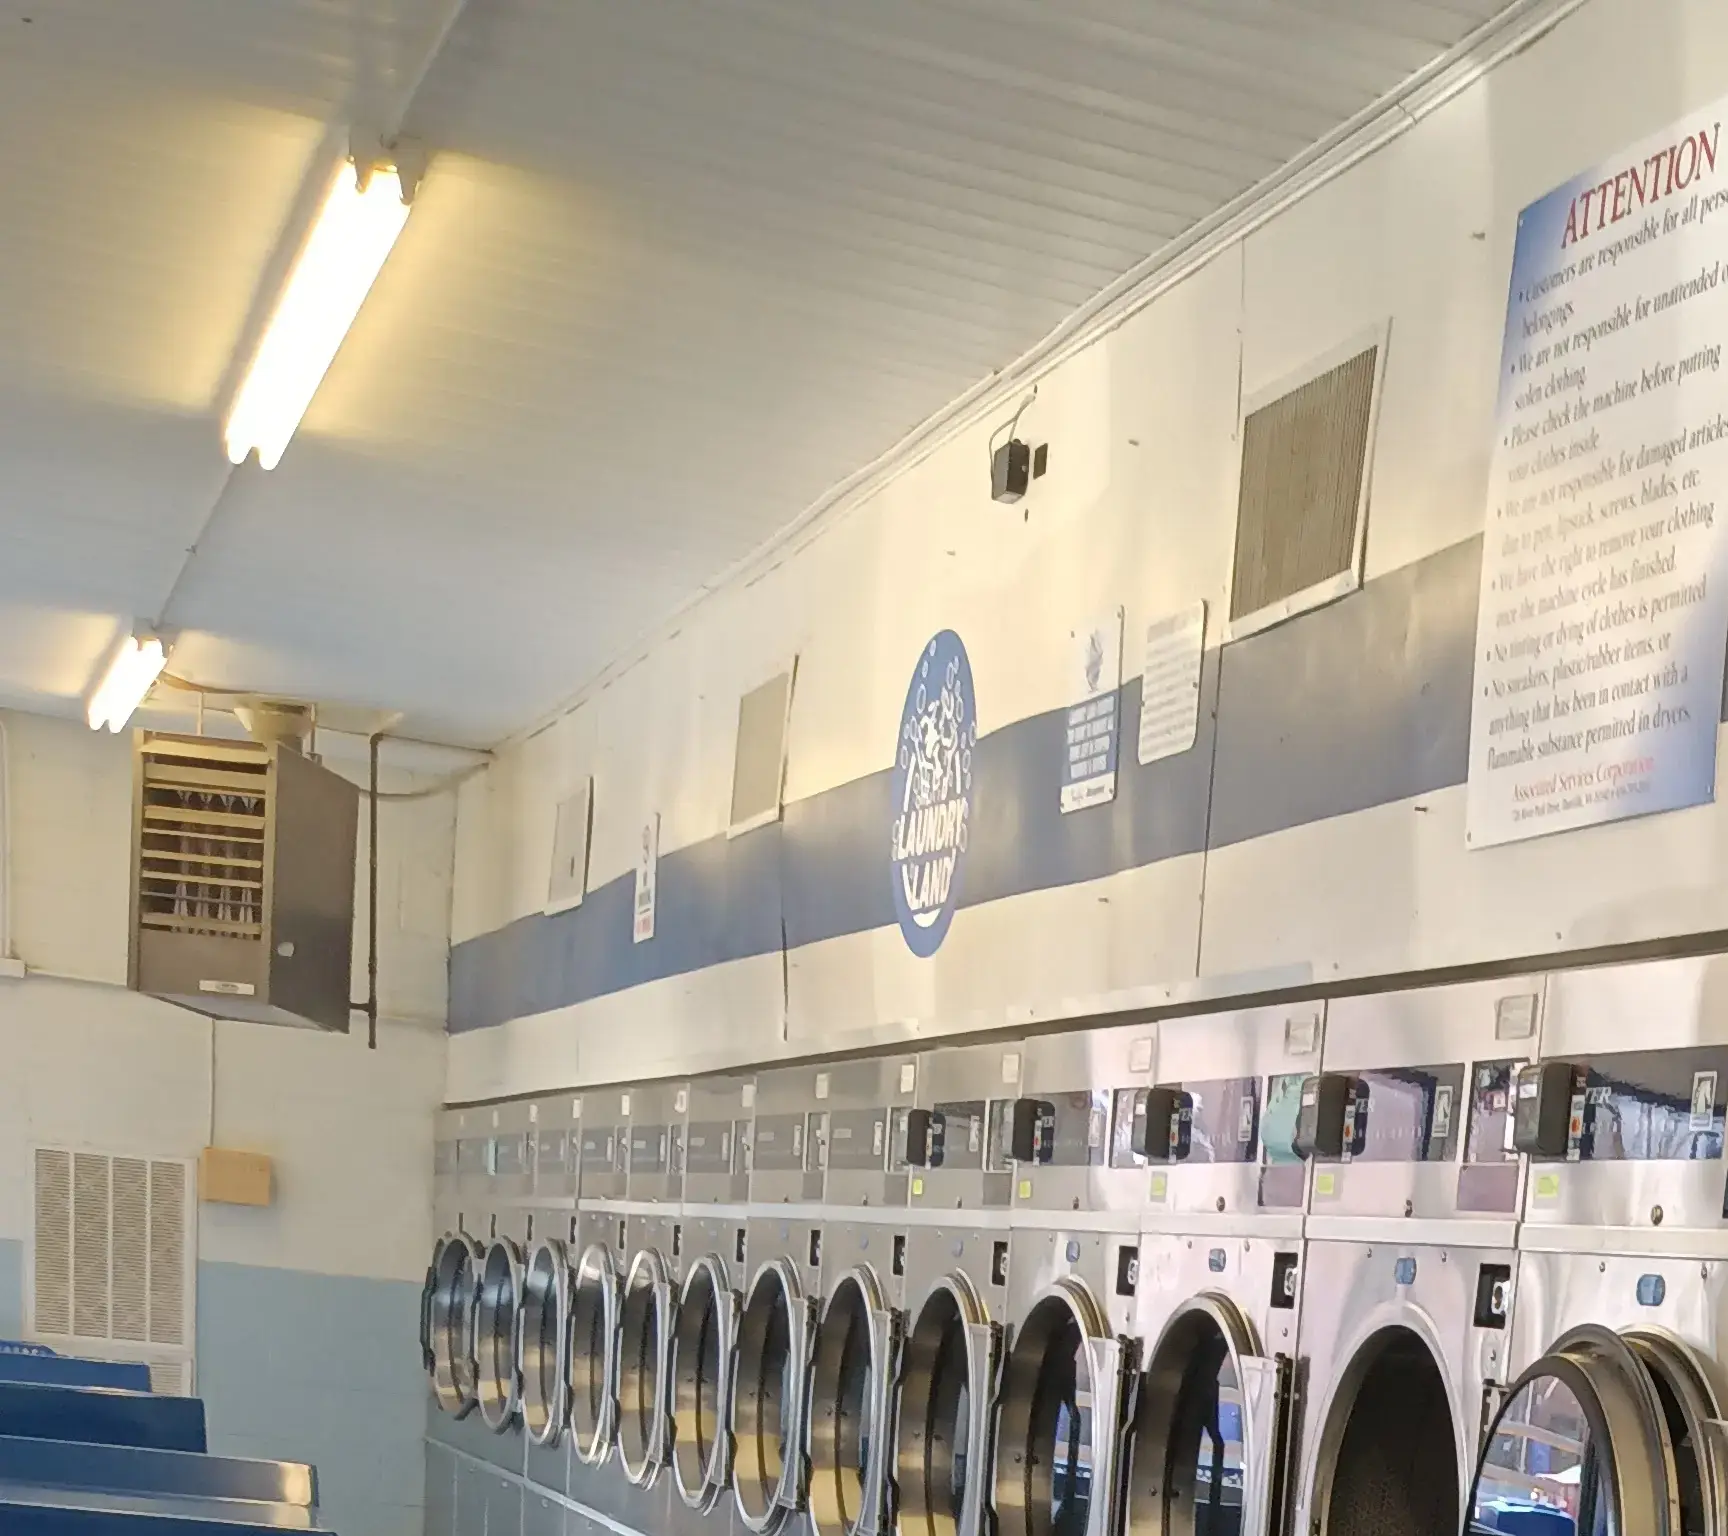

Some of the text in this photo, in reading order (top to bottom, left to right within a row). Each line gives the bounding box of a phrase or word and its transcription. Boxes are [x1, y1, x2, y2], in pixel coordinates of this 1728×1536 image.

[1561, 122, 1721, 249] ATTENTION
[1526, 264, 1576, 302] Customers
[1579, 255, 1595, 276] are
[1598, 217, 1660, 266] responsible
[1663, 209, 1679, 235] for
[1682, 195, 1698, 226] all
[1520, 354, 1534, 373] We
[1536, 348, 1551, 368] are
[1554, 337, 1570, 359] not
[1573, 304, 1632, 351] responsible
[1635, 297, 1651, 321] for
[1654, 262, 1719, 313] unattended
[1512, 345, 1721, 449] Please check the machine before putting
[1559, 458, 1616, 502] responsible
[1619, 451, 1634, 477] for
[1637, 429, 1687, 469] damaged
[1599, 530, 1637, 558] remove
[1641, 520, 1665, 543] your
[1668, 502, 1714, 534] clothing
[1582, 572, 1607, 601] cycle
[1610, 567, 1628, 591] has
[1587, 609, 1599, 635] of
[1600, 601, 1636, 631] clothes
[1639, 603, 1648, 619] is
[1651, 575, 1707, 623] permitted
[1659, 633, 1671, 652] or
[1490, 662, 1688, 736] anything that has been in contact with a
[1538, 732, 1584, 758] substance
[1586, 711, 1636, 753] permitted
[1639, 711, 1650, 733] in
[897, 798, 965, 860] LAUNDRY
[911, 857, 951, 911] LAND
